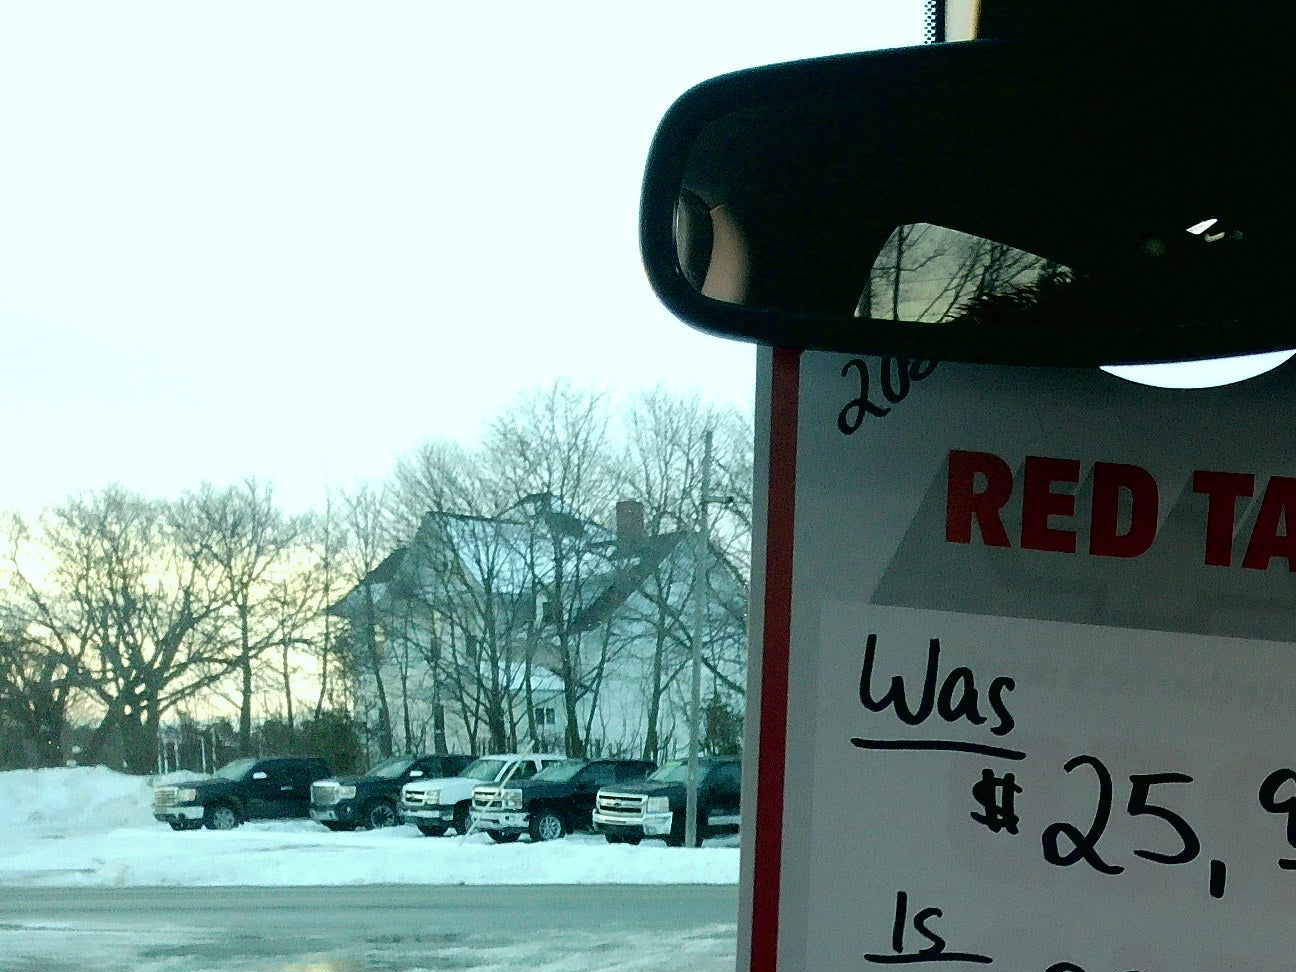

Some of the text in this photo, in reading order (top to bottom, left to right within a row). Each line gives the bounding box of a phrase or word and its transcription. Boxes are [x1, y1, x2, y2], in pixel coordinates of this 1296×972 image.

[944, 447, 1160, 559] RED
[858, 633, 1016, 736] Was
[891, 890, 946, 956] Is
